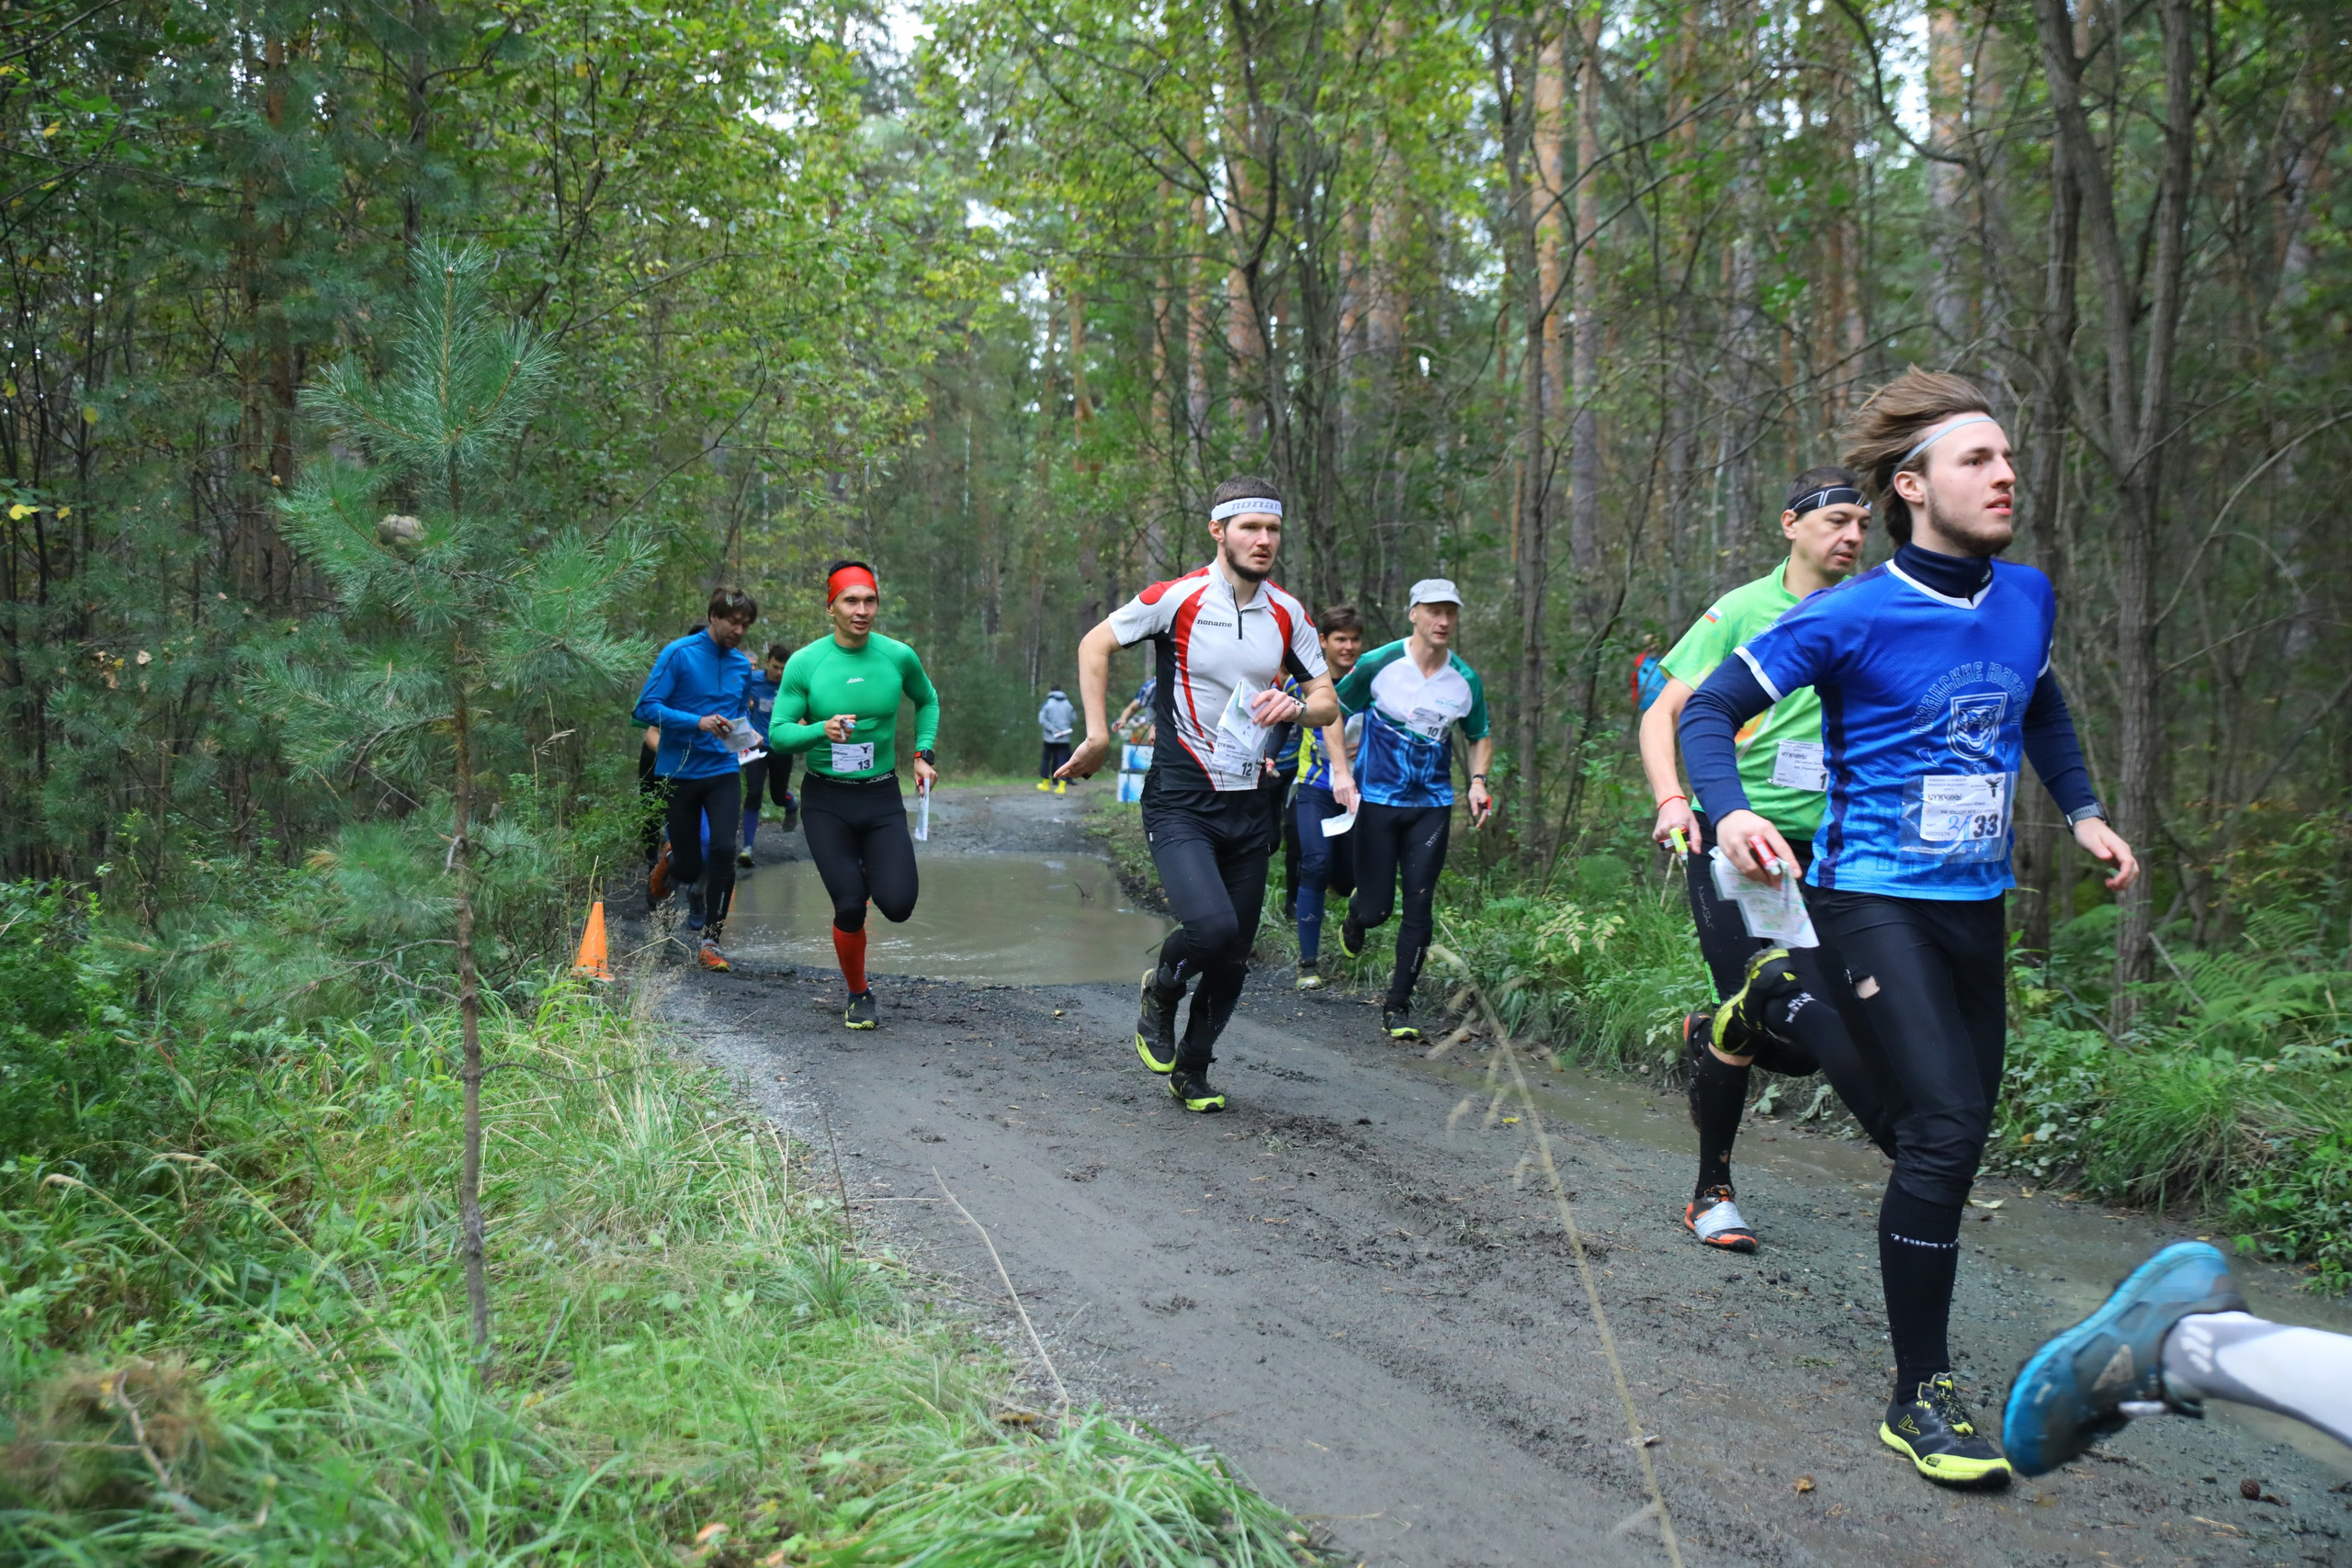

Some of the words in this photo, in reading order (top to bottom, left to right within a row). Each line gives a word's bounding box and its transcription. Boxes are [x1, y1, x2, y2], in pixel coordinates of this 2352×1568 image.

[1197, 619, 1232, 627] noname
[1428, 727, 1439, 737] 10
[858, 760, 870, 770] 13
[1241, 761, 1252, 777] 12
[1973, 813, 1999, 839] 33
